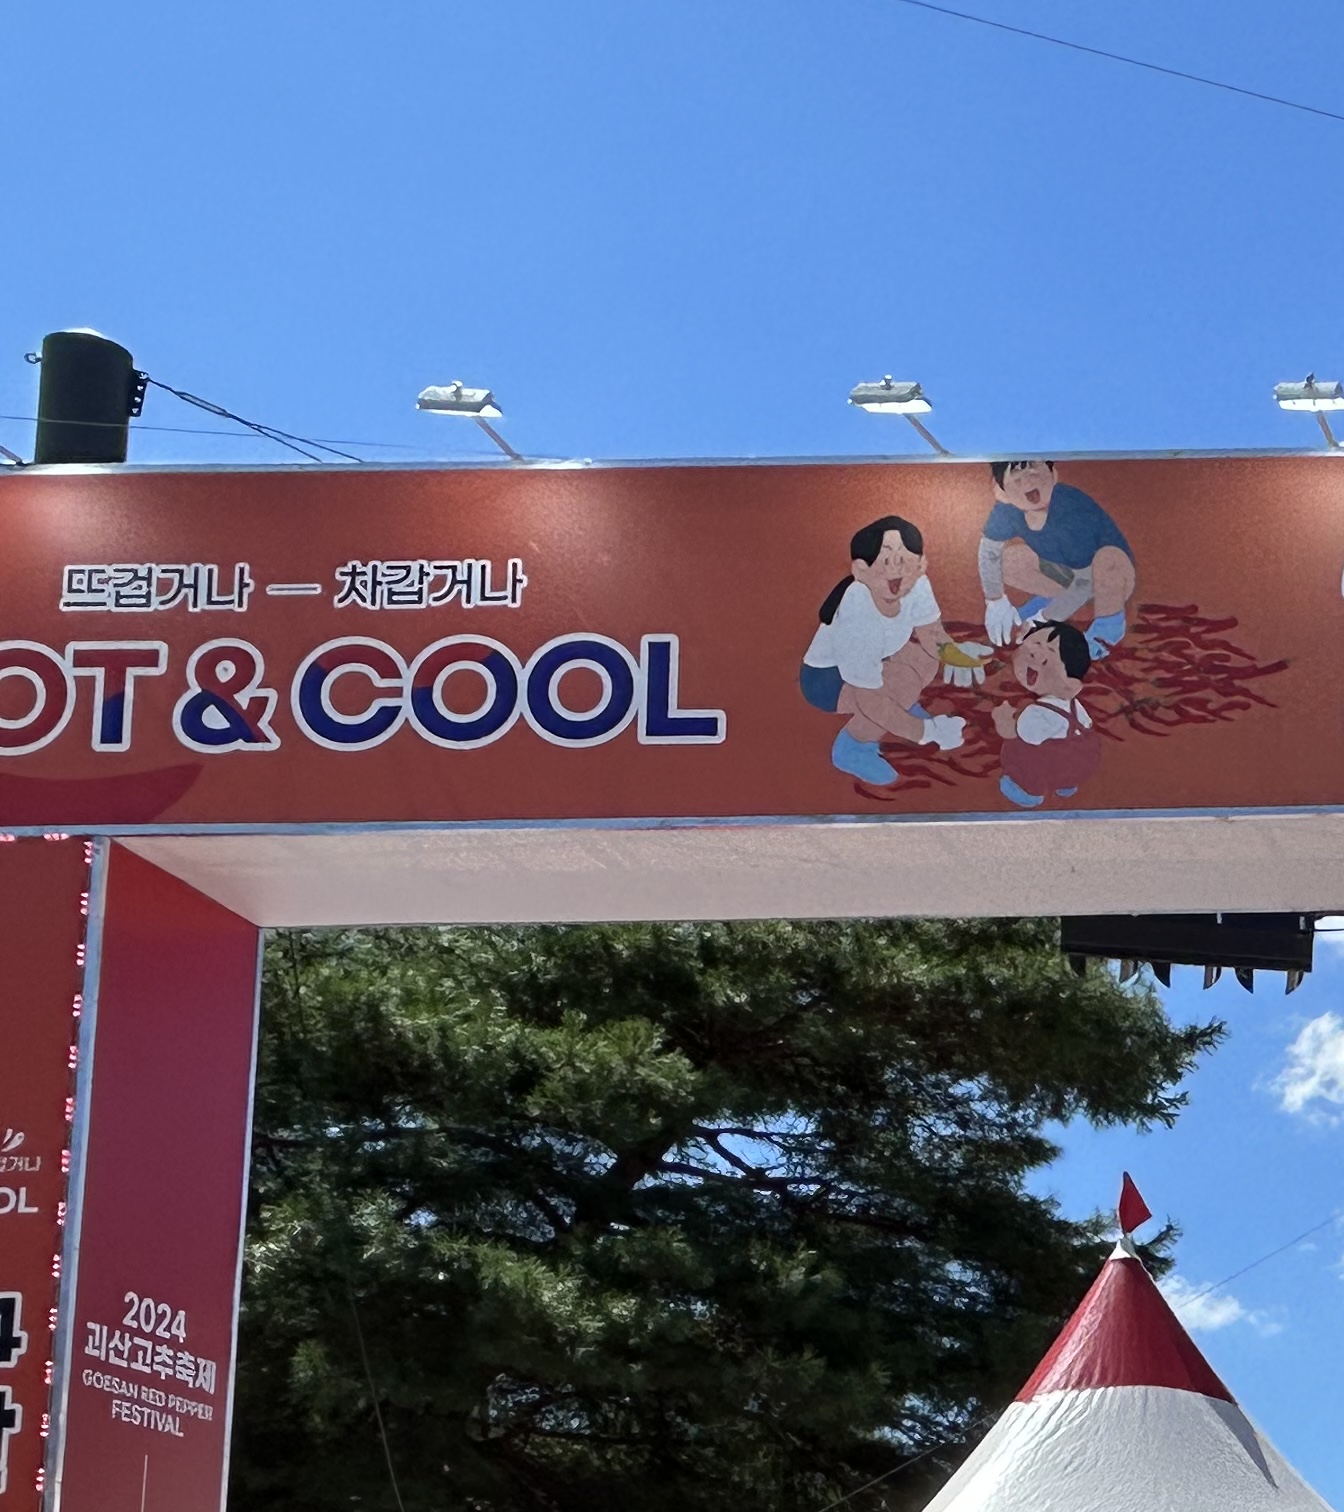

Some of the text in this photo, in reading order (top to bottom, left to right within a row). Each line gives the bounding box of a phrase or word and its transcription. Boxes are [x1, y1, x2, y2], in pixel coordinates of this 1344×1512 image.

[61, 558, 527, 613] 뜨겁거나 차갑거나
[173, 638, 280, 753] &
[291, 633, 726, 751] COOL
[0, 1156, 41, 1173] 거나
[122, 1291, 187, 1343] 2024
[84, 1321, 217, 1395] 괴산고추축제
[82, 1369, 138, 1399] GOESAN
[141, 1386, 166, 1406] RED
[112, 1399, 184, 1437] FESTIVAL
